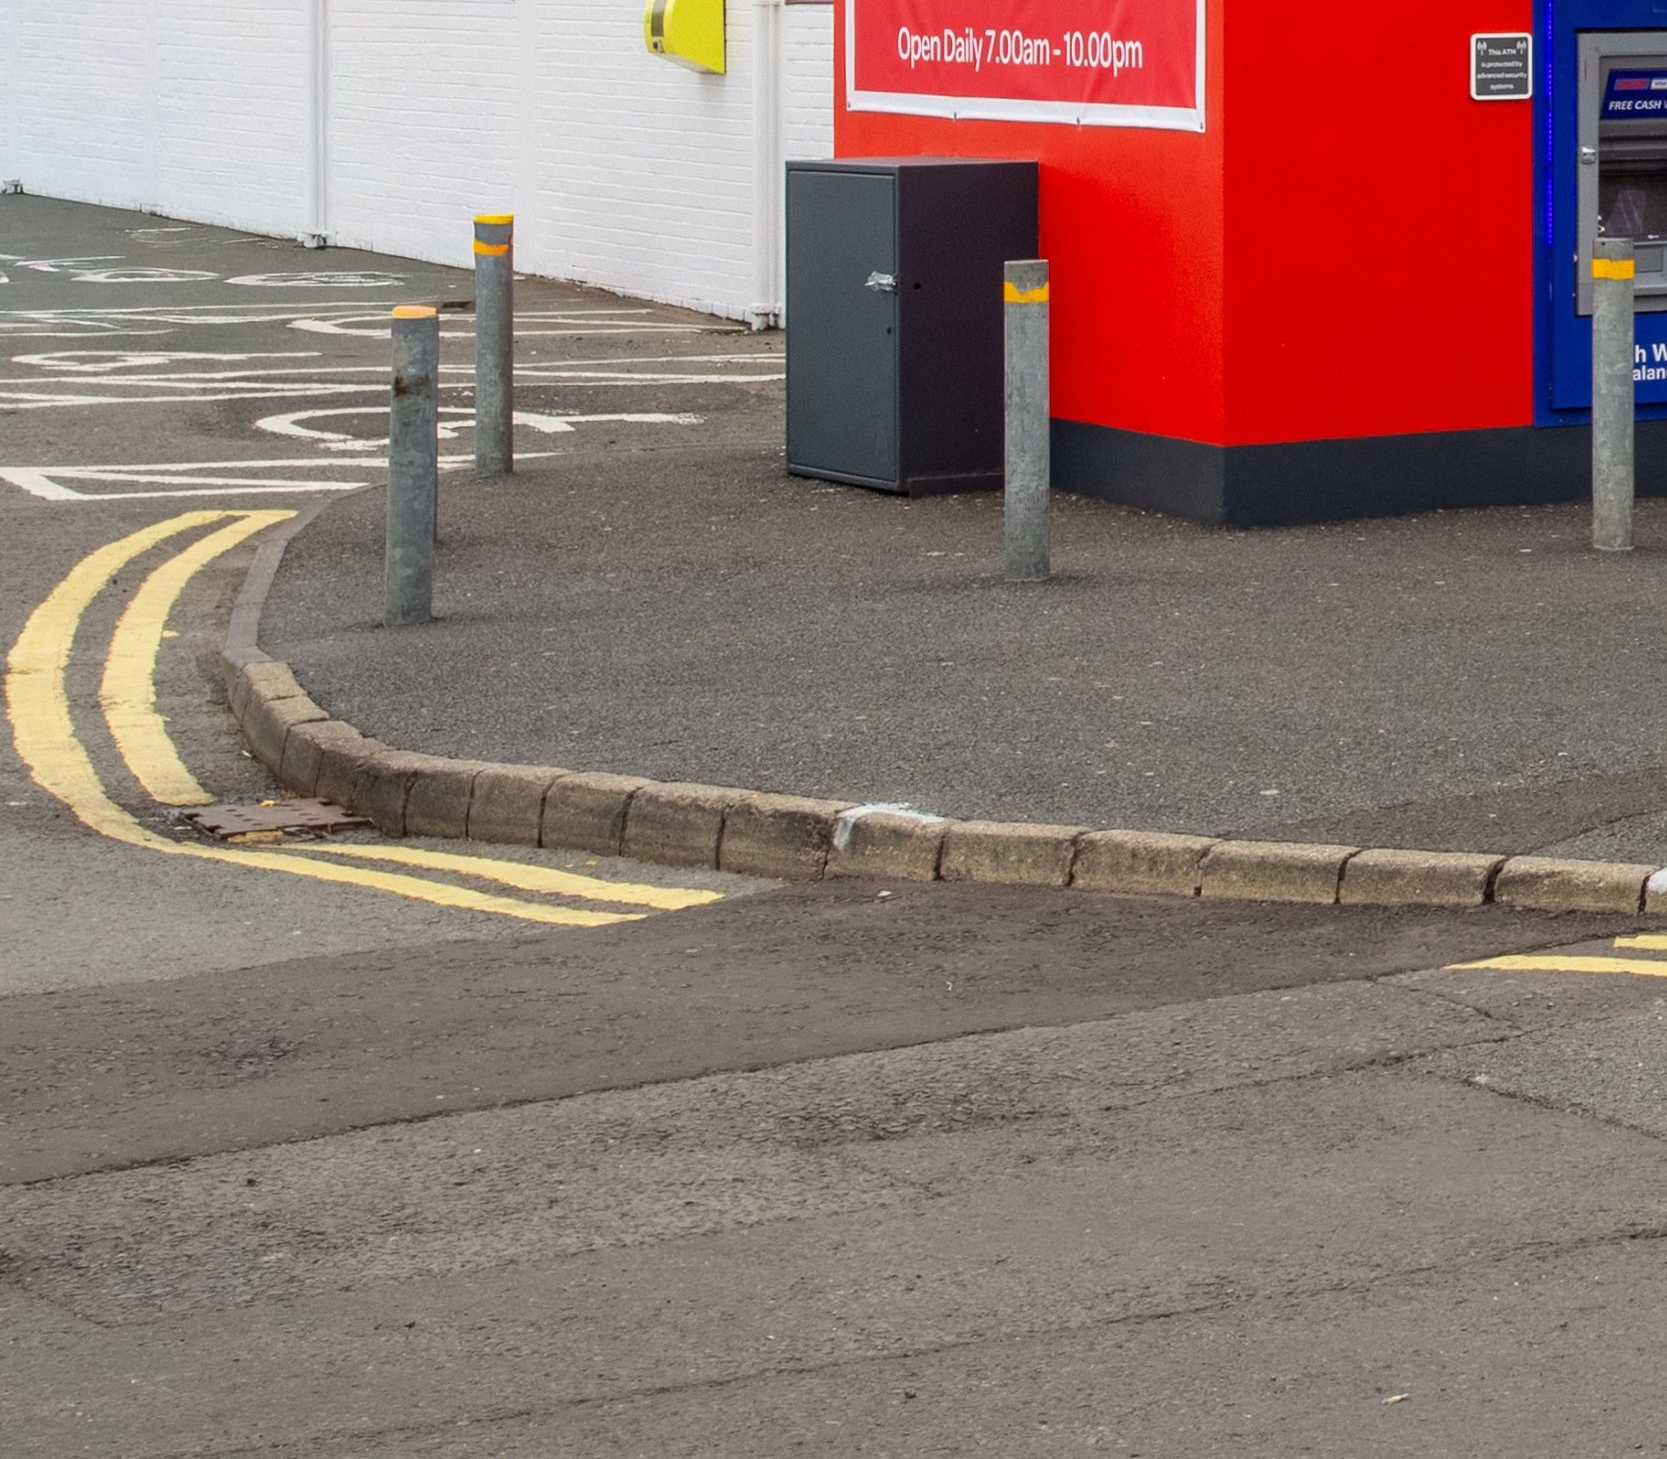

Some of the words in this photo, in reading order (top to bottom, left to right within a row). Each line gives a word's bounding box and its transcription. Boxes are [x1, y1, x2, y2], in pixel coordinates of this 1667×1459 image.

[897, 27, 940, 69] Open
[943, 28, 983, 72] Daily
[984, 30, 1050, 65] 7.00am
[1063, 31, 1143, 77] 10.00pm
[1609, 100, 1633, 110] FREE
[1634, 99, 1662, 110] CASH
